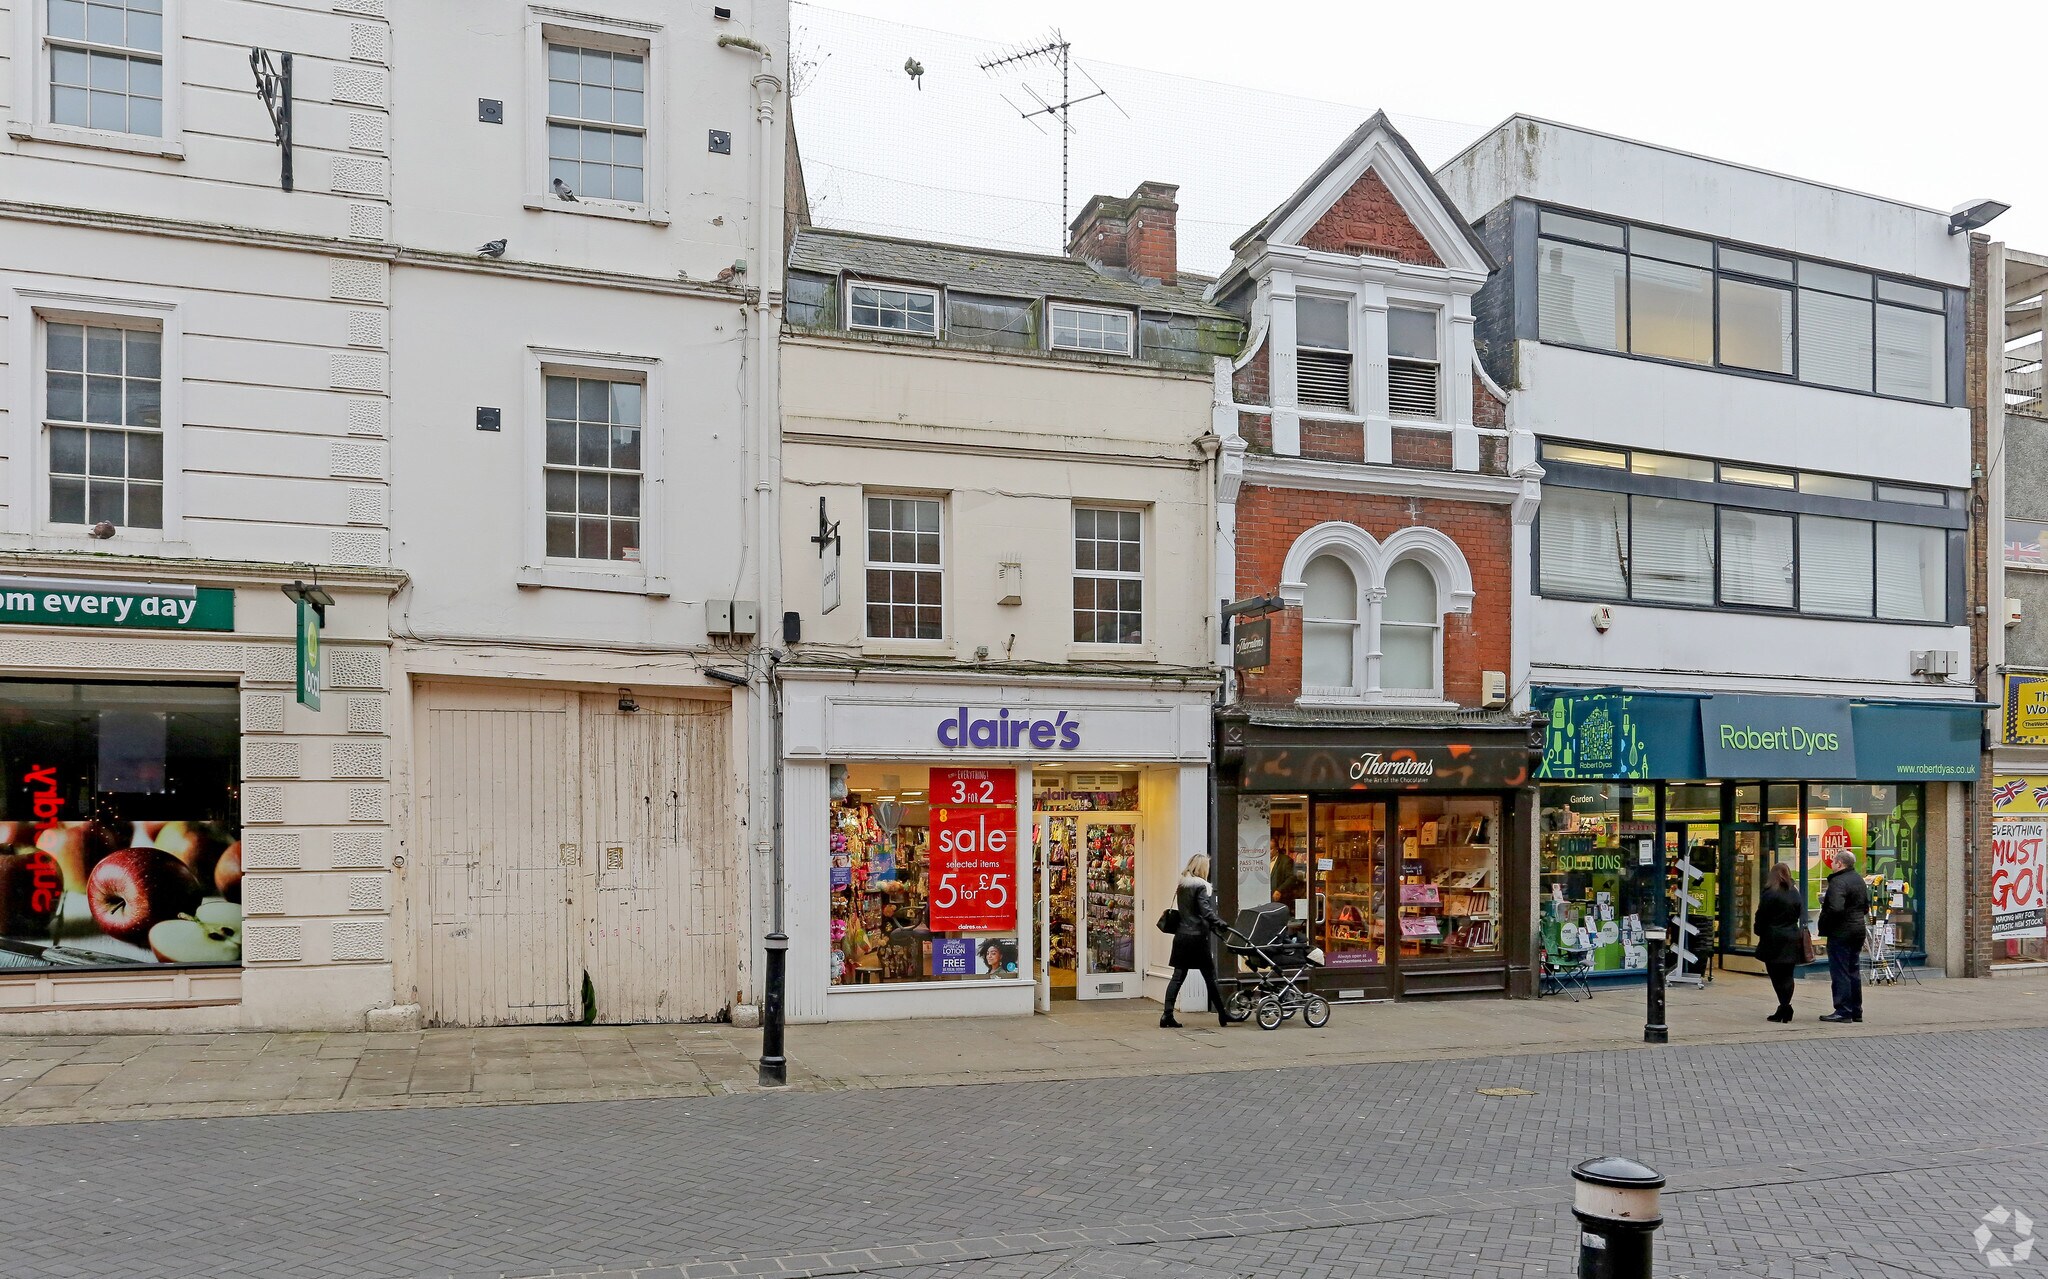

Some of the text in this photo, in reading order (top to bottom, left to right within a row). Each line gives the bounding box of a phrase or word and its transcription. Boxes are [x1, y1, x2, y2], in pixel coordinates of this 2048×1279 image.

[0, 591, 197, 624] m every day
[1236, 637, 1264, 654] Thorntons
[304, 661, 320, 698] local
[2035, 691, 2048, 702] Th
[2026, 704, 2048, 714] Wo
[937, 706, 1080, 750] claire's
[1720, 724, 1839, 756] Robert Dyas
[1350, 752, 1433, 780] Thorntons
[1896, 764, 1976, 776] www.robertdyas.co.uk
[957, 770, 989, 780] EVERYTHING!
[950, 780, 966, 804] 3
[967, 792, 978, 803] FOR
[1570, 794, 1594, 804] Garden
[939, 815, 1007, 852] sale
[1992, 825, 2043, 837] EVERYTHING
[1824, 835, 1848, 848] HALF
[1992, 838, 2044, 867] MUST
[946, 859, 999, 869] selected items
[1560, 855, 1621, 870] SOLUTIONS
[935, 874, 957, 909] 5
[960, 885, 978, 899] for
[1992, 863, 2044, 911] GO!
[1995, 910, 2035, 924] MAKING WAY FOR
[1992, 922, 2014, 933] ANTASTIC
[2014, 920, 2025, 928] NEW
[943, 959, 966, 968] FREE
